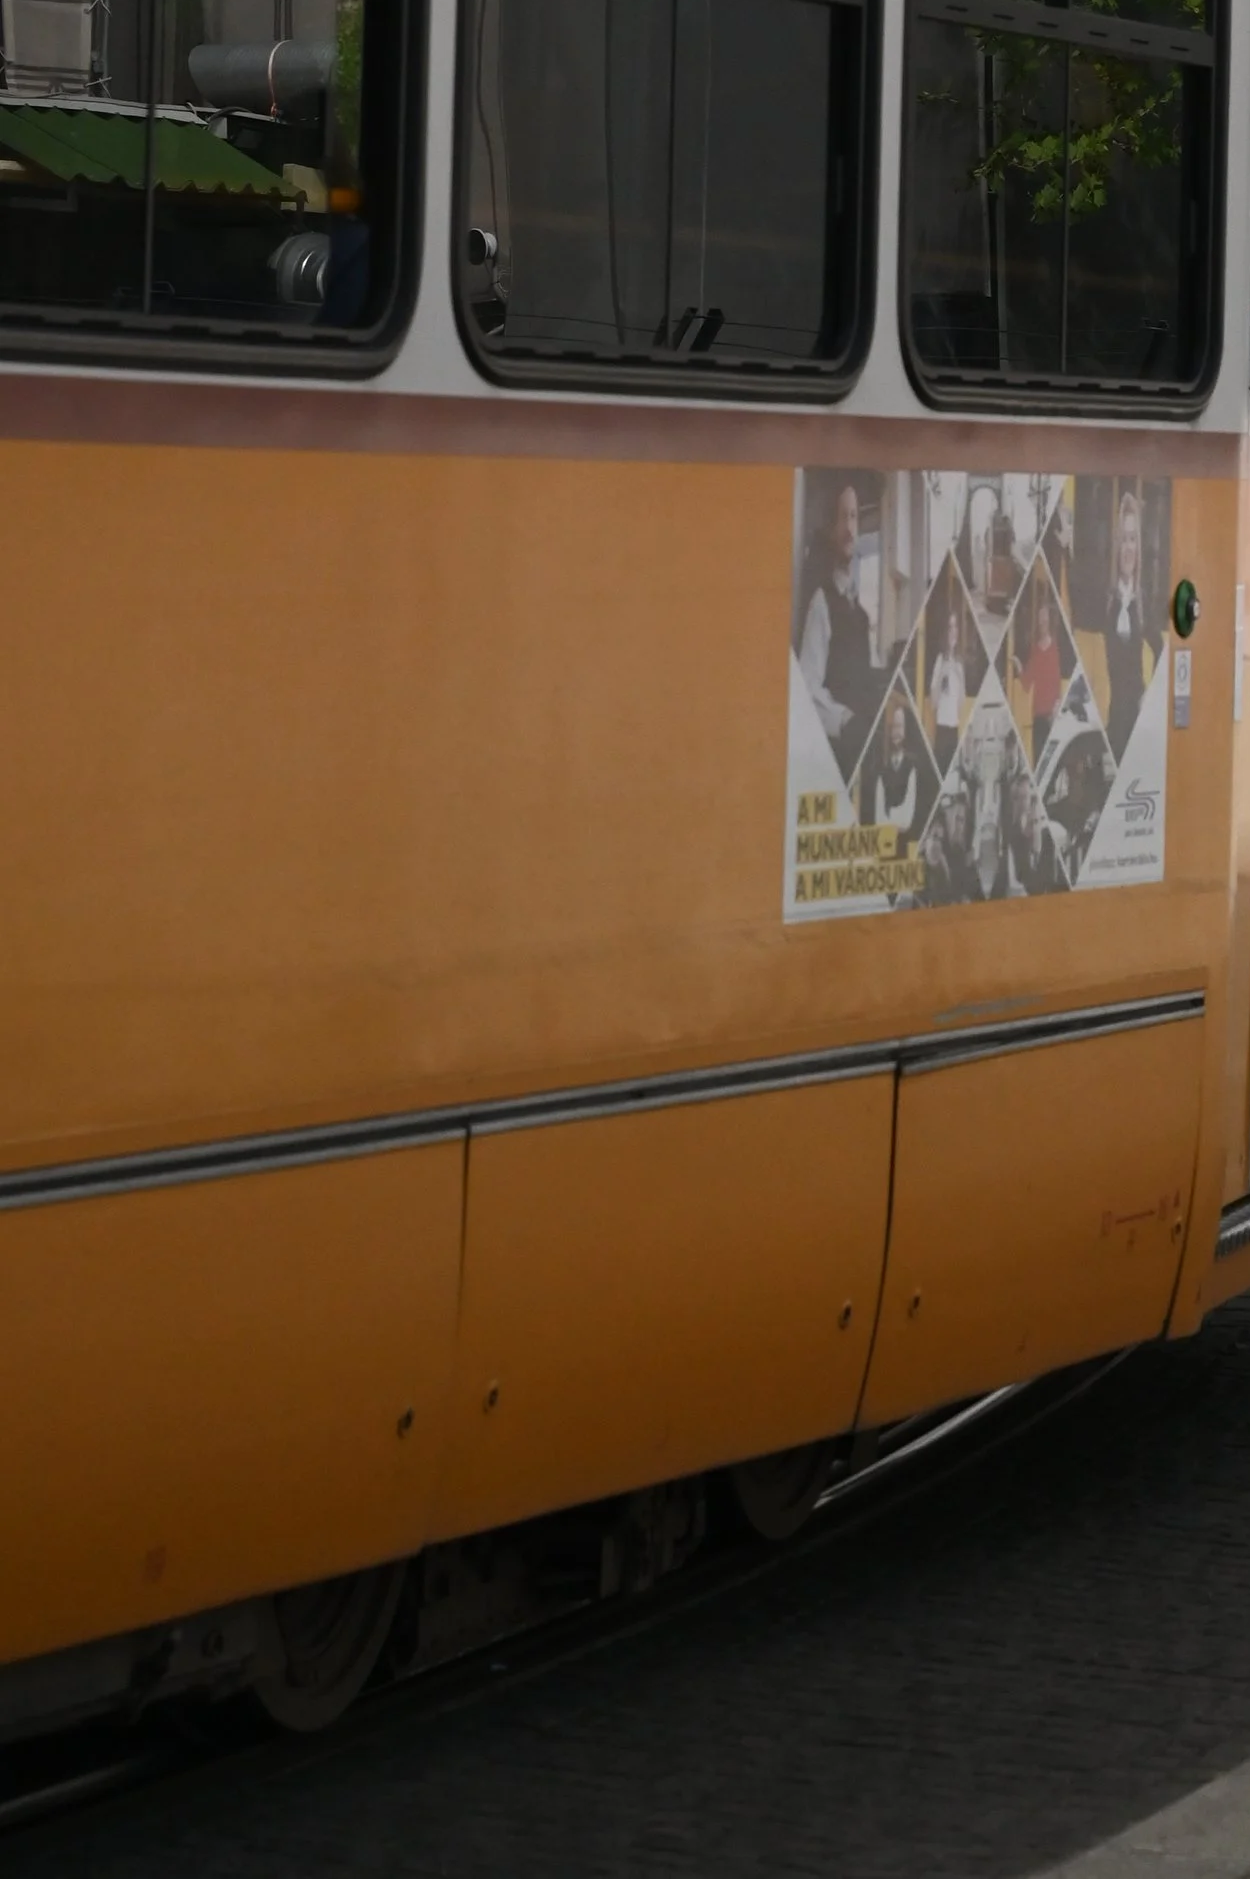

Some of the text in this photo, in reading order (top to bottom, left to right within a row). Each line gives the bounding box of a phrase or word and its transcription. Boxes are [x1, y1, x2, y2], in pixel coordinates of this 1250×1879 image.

[798, 793, 833, 826] A MI
[795, 871, 807, 902] A
[811, 869, 830, 899] MI
